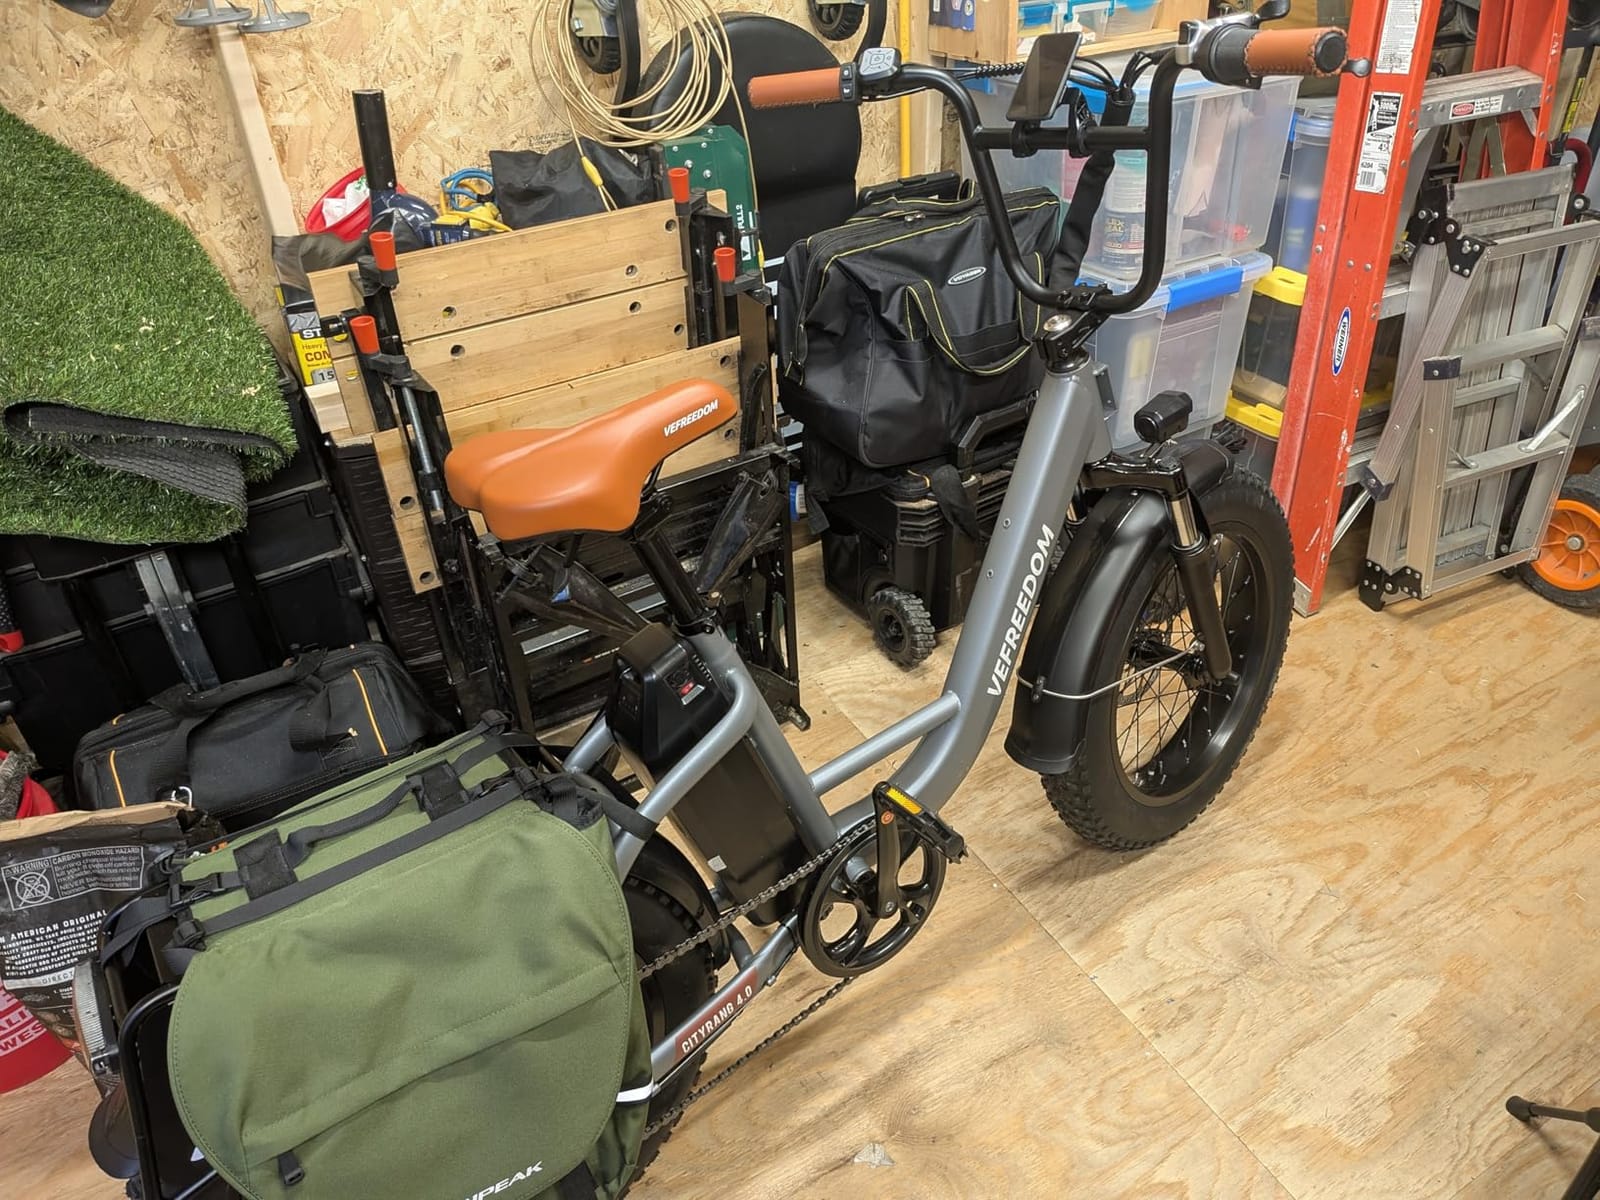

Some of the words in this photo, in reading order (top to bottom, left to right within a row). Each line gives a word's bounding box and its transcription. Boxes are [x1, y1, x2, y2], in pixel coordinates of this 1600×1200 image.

[302, 328, 322, 339] ST
[1335, 321, 1348, 362] WERNER
[318, 371, 335, 381] 15
[664, 398, 719, 437] VEFREEDOM
[986, 523, 1055, 697] VEFREEDOM
[12, 860, 50, 875] WARNING
[52, 853, 81, 865] CARBON
[10, 923, 59, 941] AMERICAN
[62, 909, 108, 928] ORIGINAL
[736, 985, 753, 1006] 4.0
